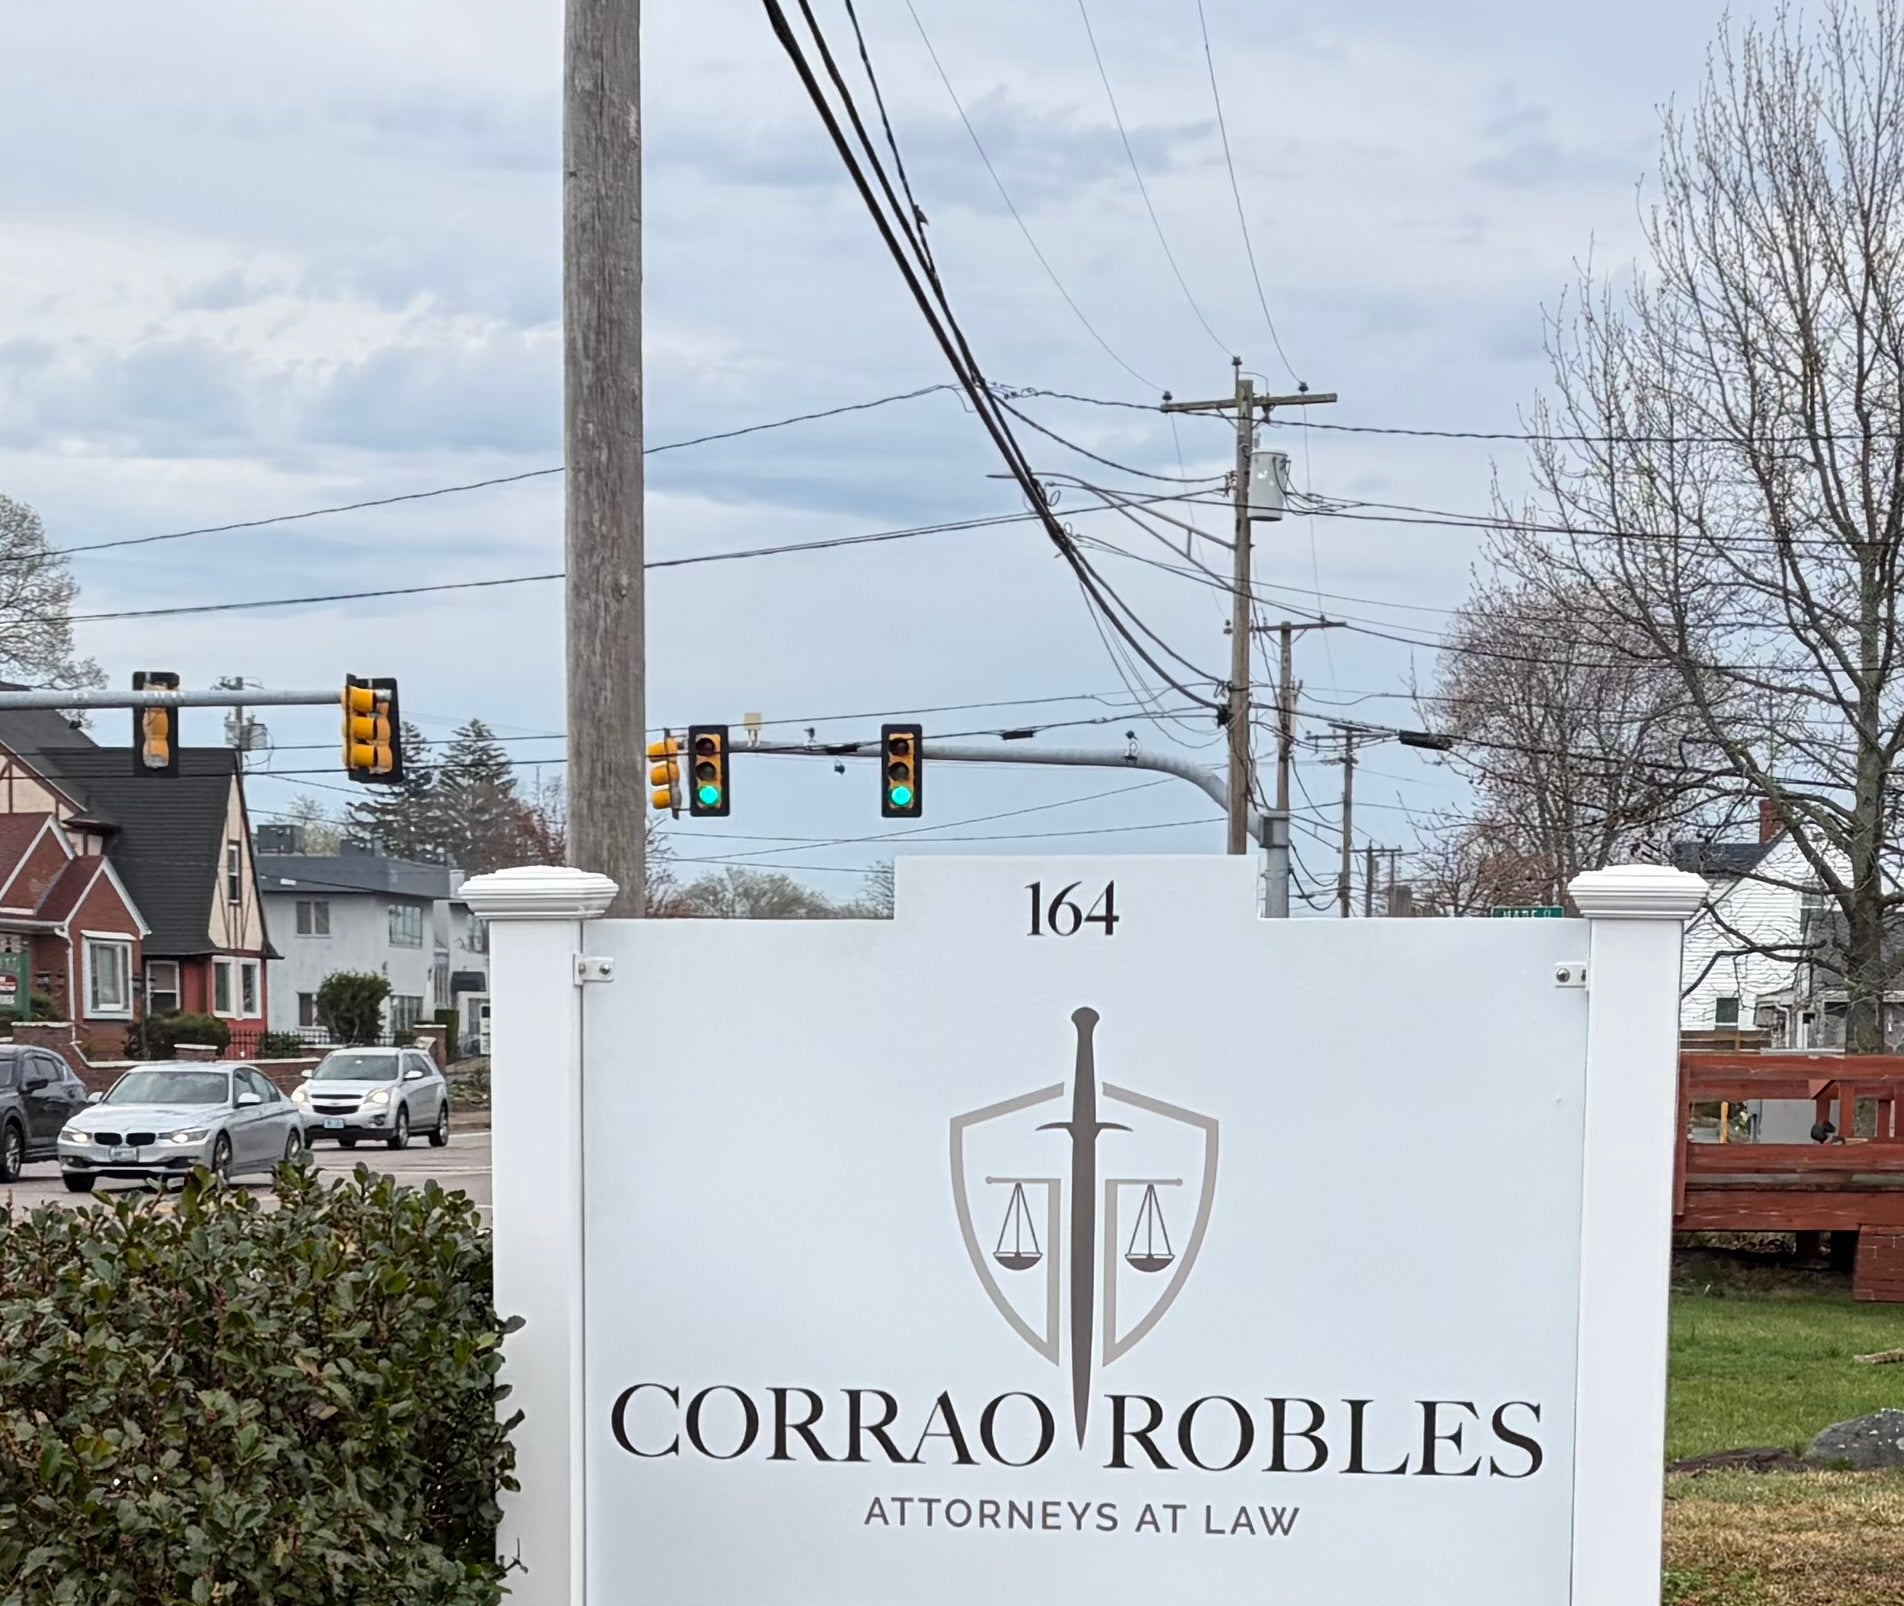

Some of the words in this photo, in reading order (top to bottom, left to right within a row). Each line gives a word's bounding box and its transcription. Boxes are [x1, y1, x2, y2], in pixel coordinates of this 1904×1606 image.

[1025, 880, 1119, 936] 164
[611, 1383, 1055, 1467] CORRAO
[1103, 1394, 1543, 1478] ROBLES
[864, 1497, 1118, 1531] ATTORNEYS
[1135, 1504, 1187, 1533] AT
[1205, 1505, 1299, 1536] LAW
